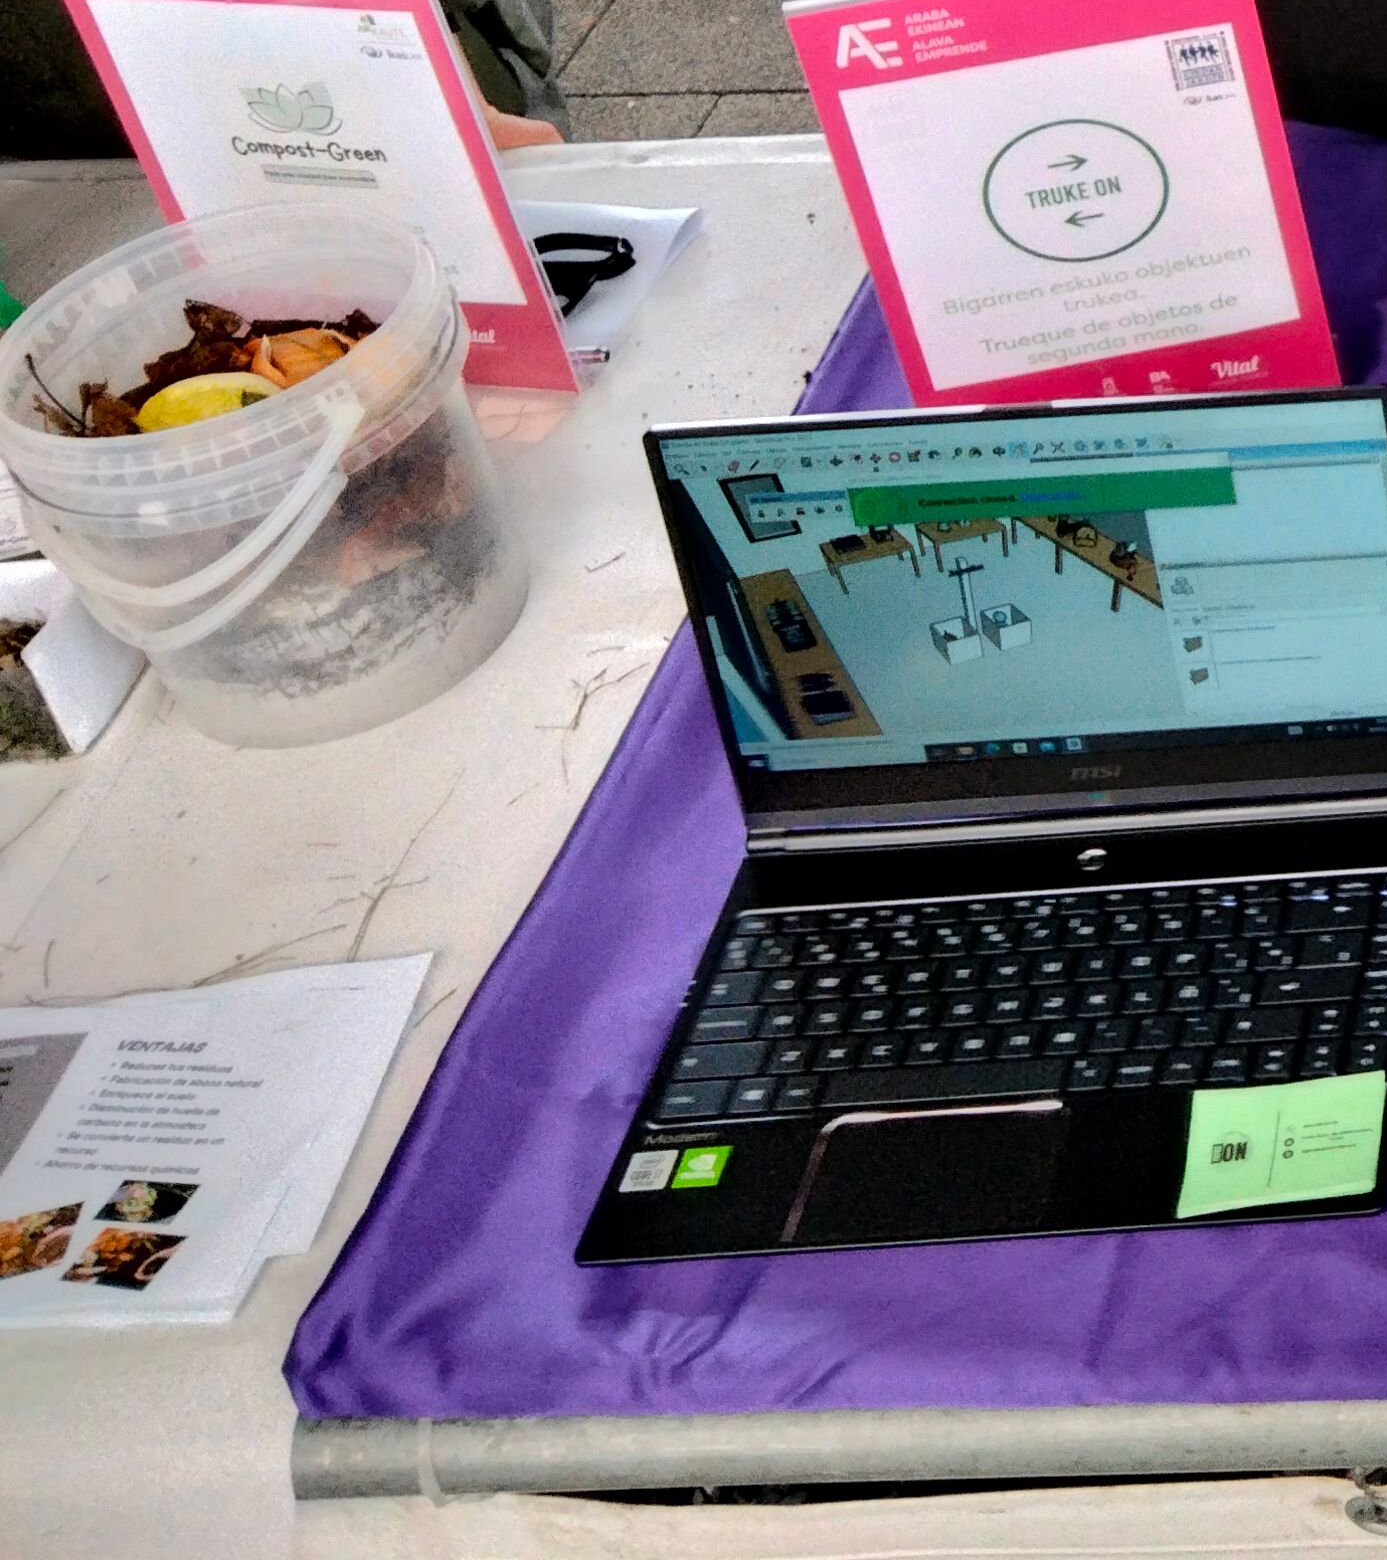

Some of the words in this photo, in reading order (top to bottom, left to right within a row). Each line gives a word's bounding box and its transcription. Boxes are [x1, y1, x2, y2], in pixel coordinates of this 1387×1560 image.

[905, 8, 950, 25] ARABA
[231, 136, 388, 163] Compost-Green
[1025, 181, 1088, 210] TRUKE
[1094, 176, 1122, 197] ON
[942, 285, 1044, 317] Bigarren
[1050, 269, 1129, 295] eskuko
[1135, 246, 1251, 280] objektuen
[980, 320, 1075, 355] Trueque
[1082, 312, 1112, 334] de
[1117, 302, 1203, 331] objetos
[1209, 293, 1239, 311] de
[1027, 335, 1127, 366] segunda
[1210, 355, 1261, 381] Vital
[117, 1040, 208, 1053] VENTAJAS
